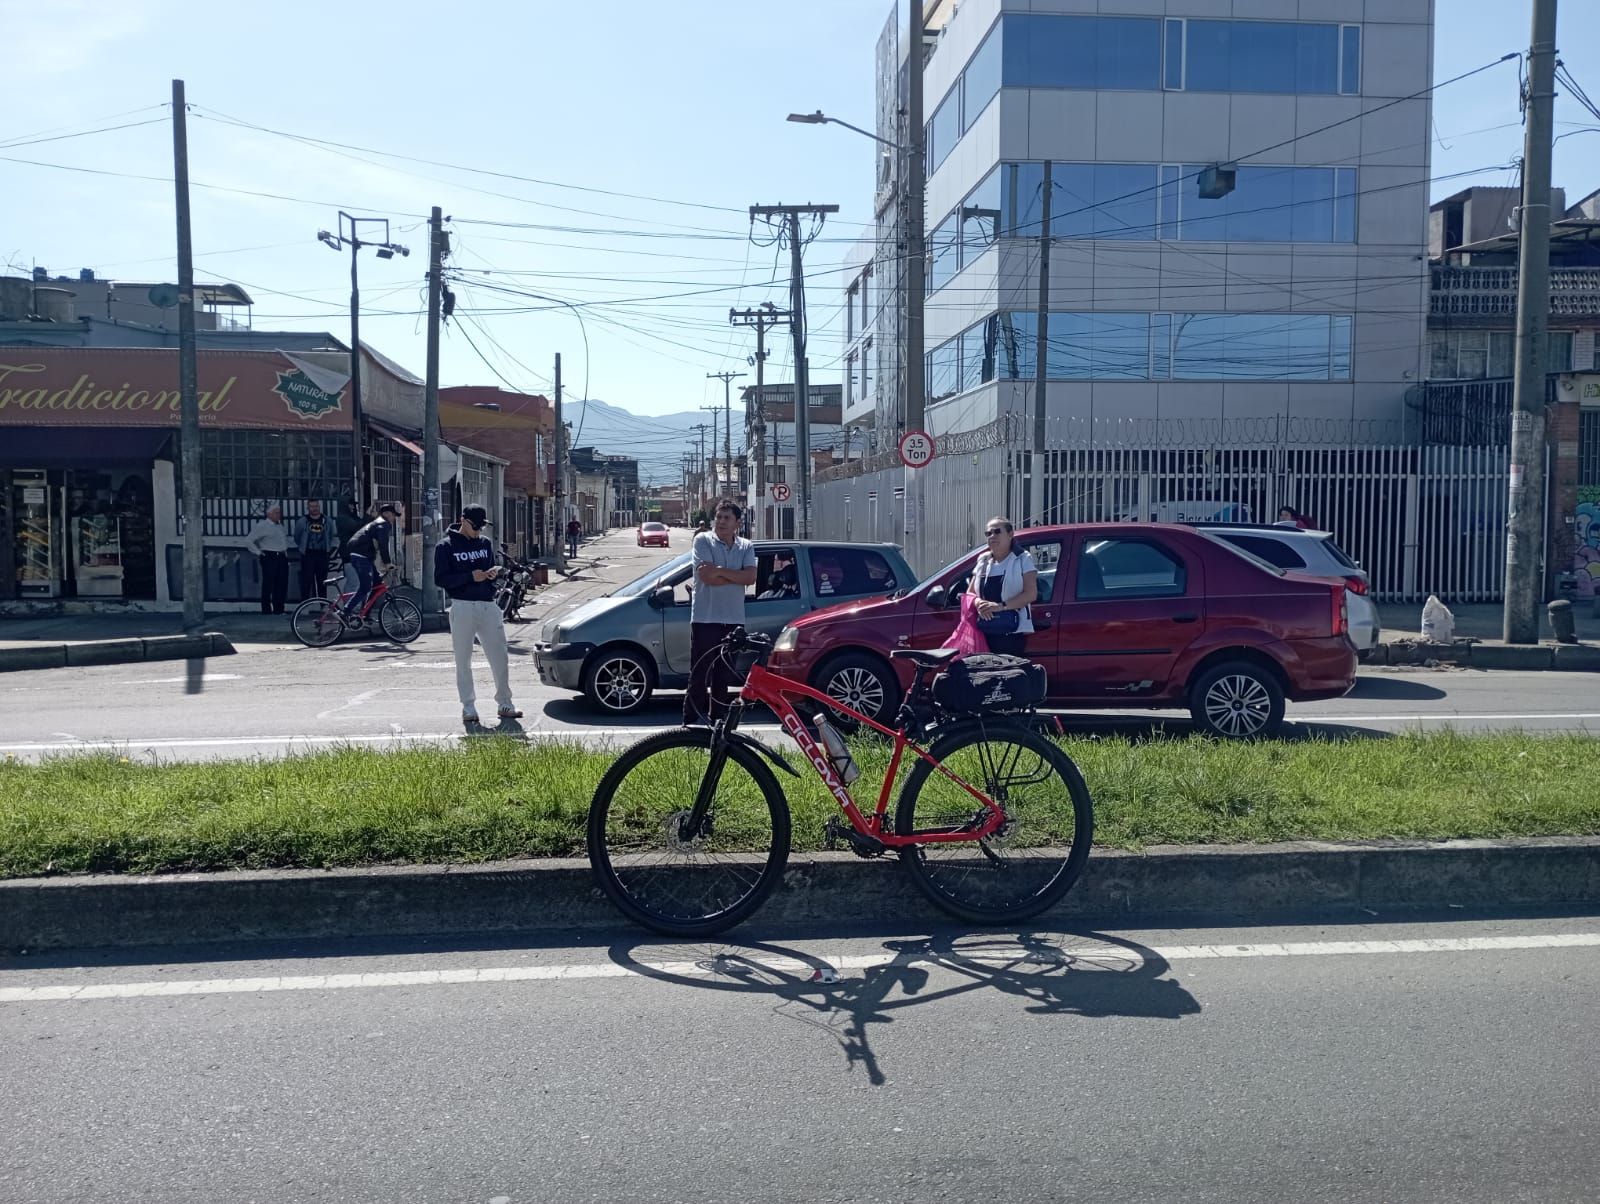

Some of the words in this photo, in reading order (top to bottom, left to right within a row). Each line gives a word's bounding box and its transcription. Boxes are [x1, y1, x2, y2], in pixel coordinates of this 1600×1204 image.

[287, 382, 328, 400] NATURAL
[909, 438, 924, 449] 3.5
[907, 449, 927, 459] Ton
[453, 549, 488, 562] TOMMY
